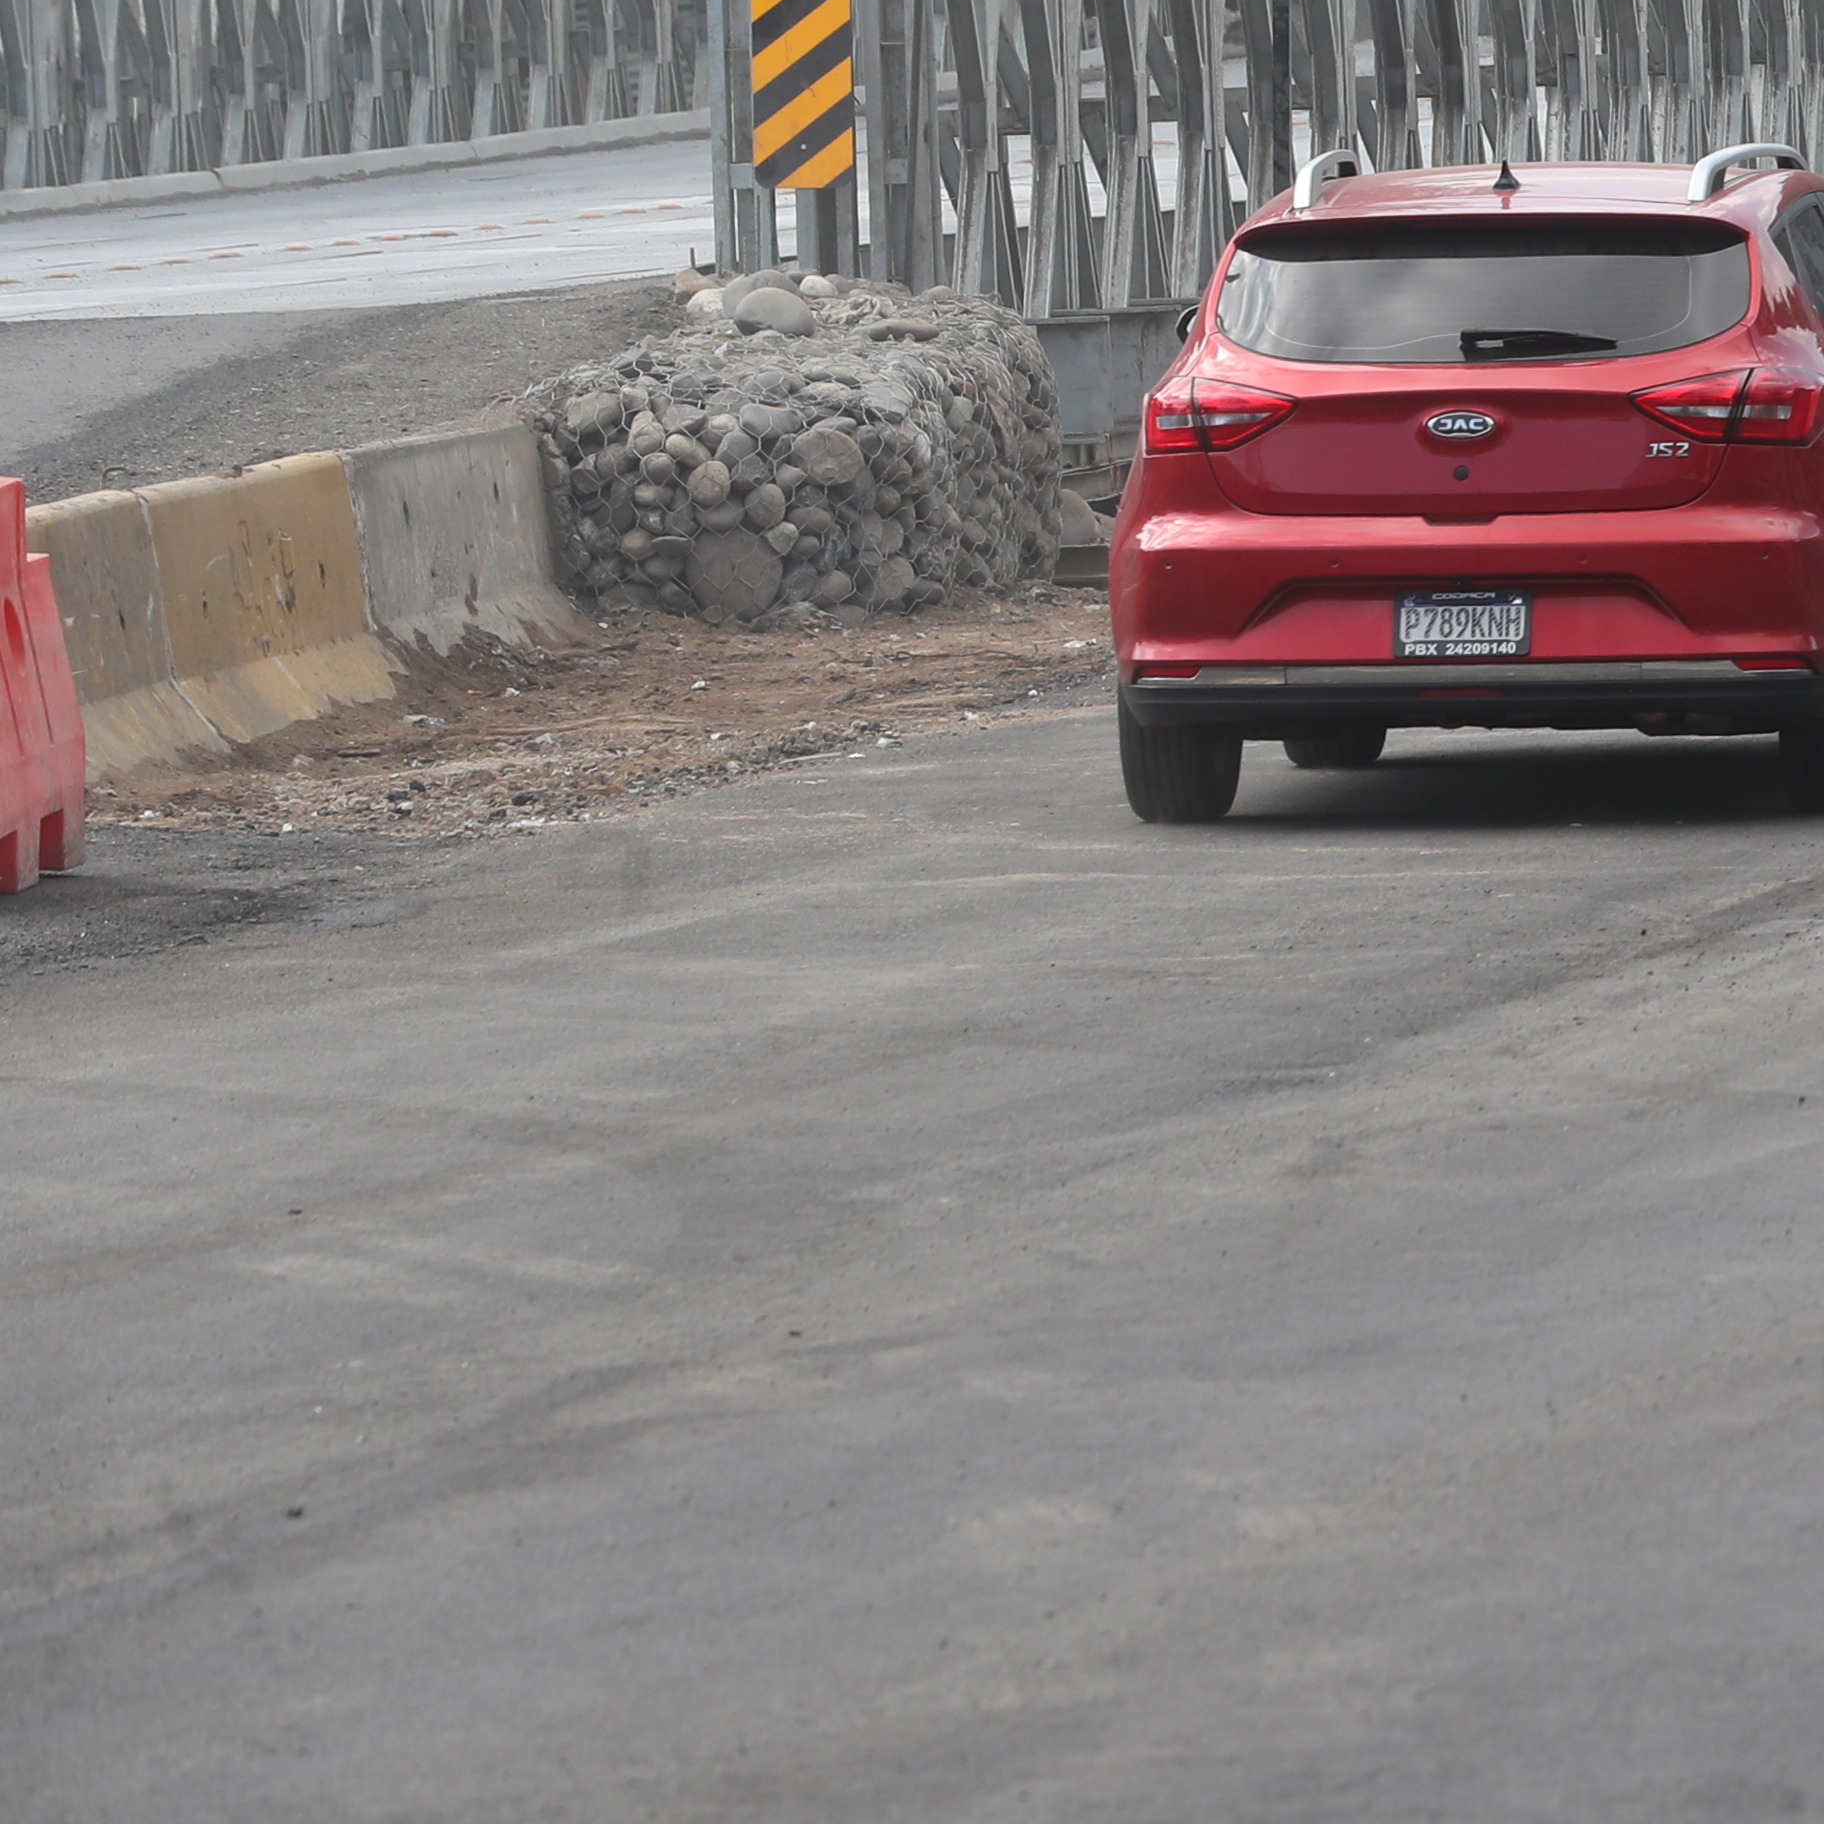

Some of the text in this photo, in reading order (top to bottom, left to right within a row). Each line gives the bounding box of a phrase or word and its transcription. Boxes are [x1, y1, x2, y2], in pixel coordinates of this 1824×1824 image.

[1438, 418, 1484, 431] JAC
[1645, 442, 1690, 458] JS2
[1404, 607, 1522, 639] P789KNH
[1404, 642, 1517, 655] PBX 24209140
